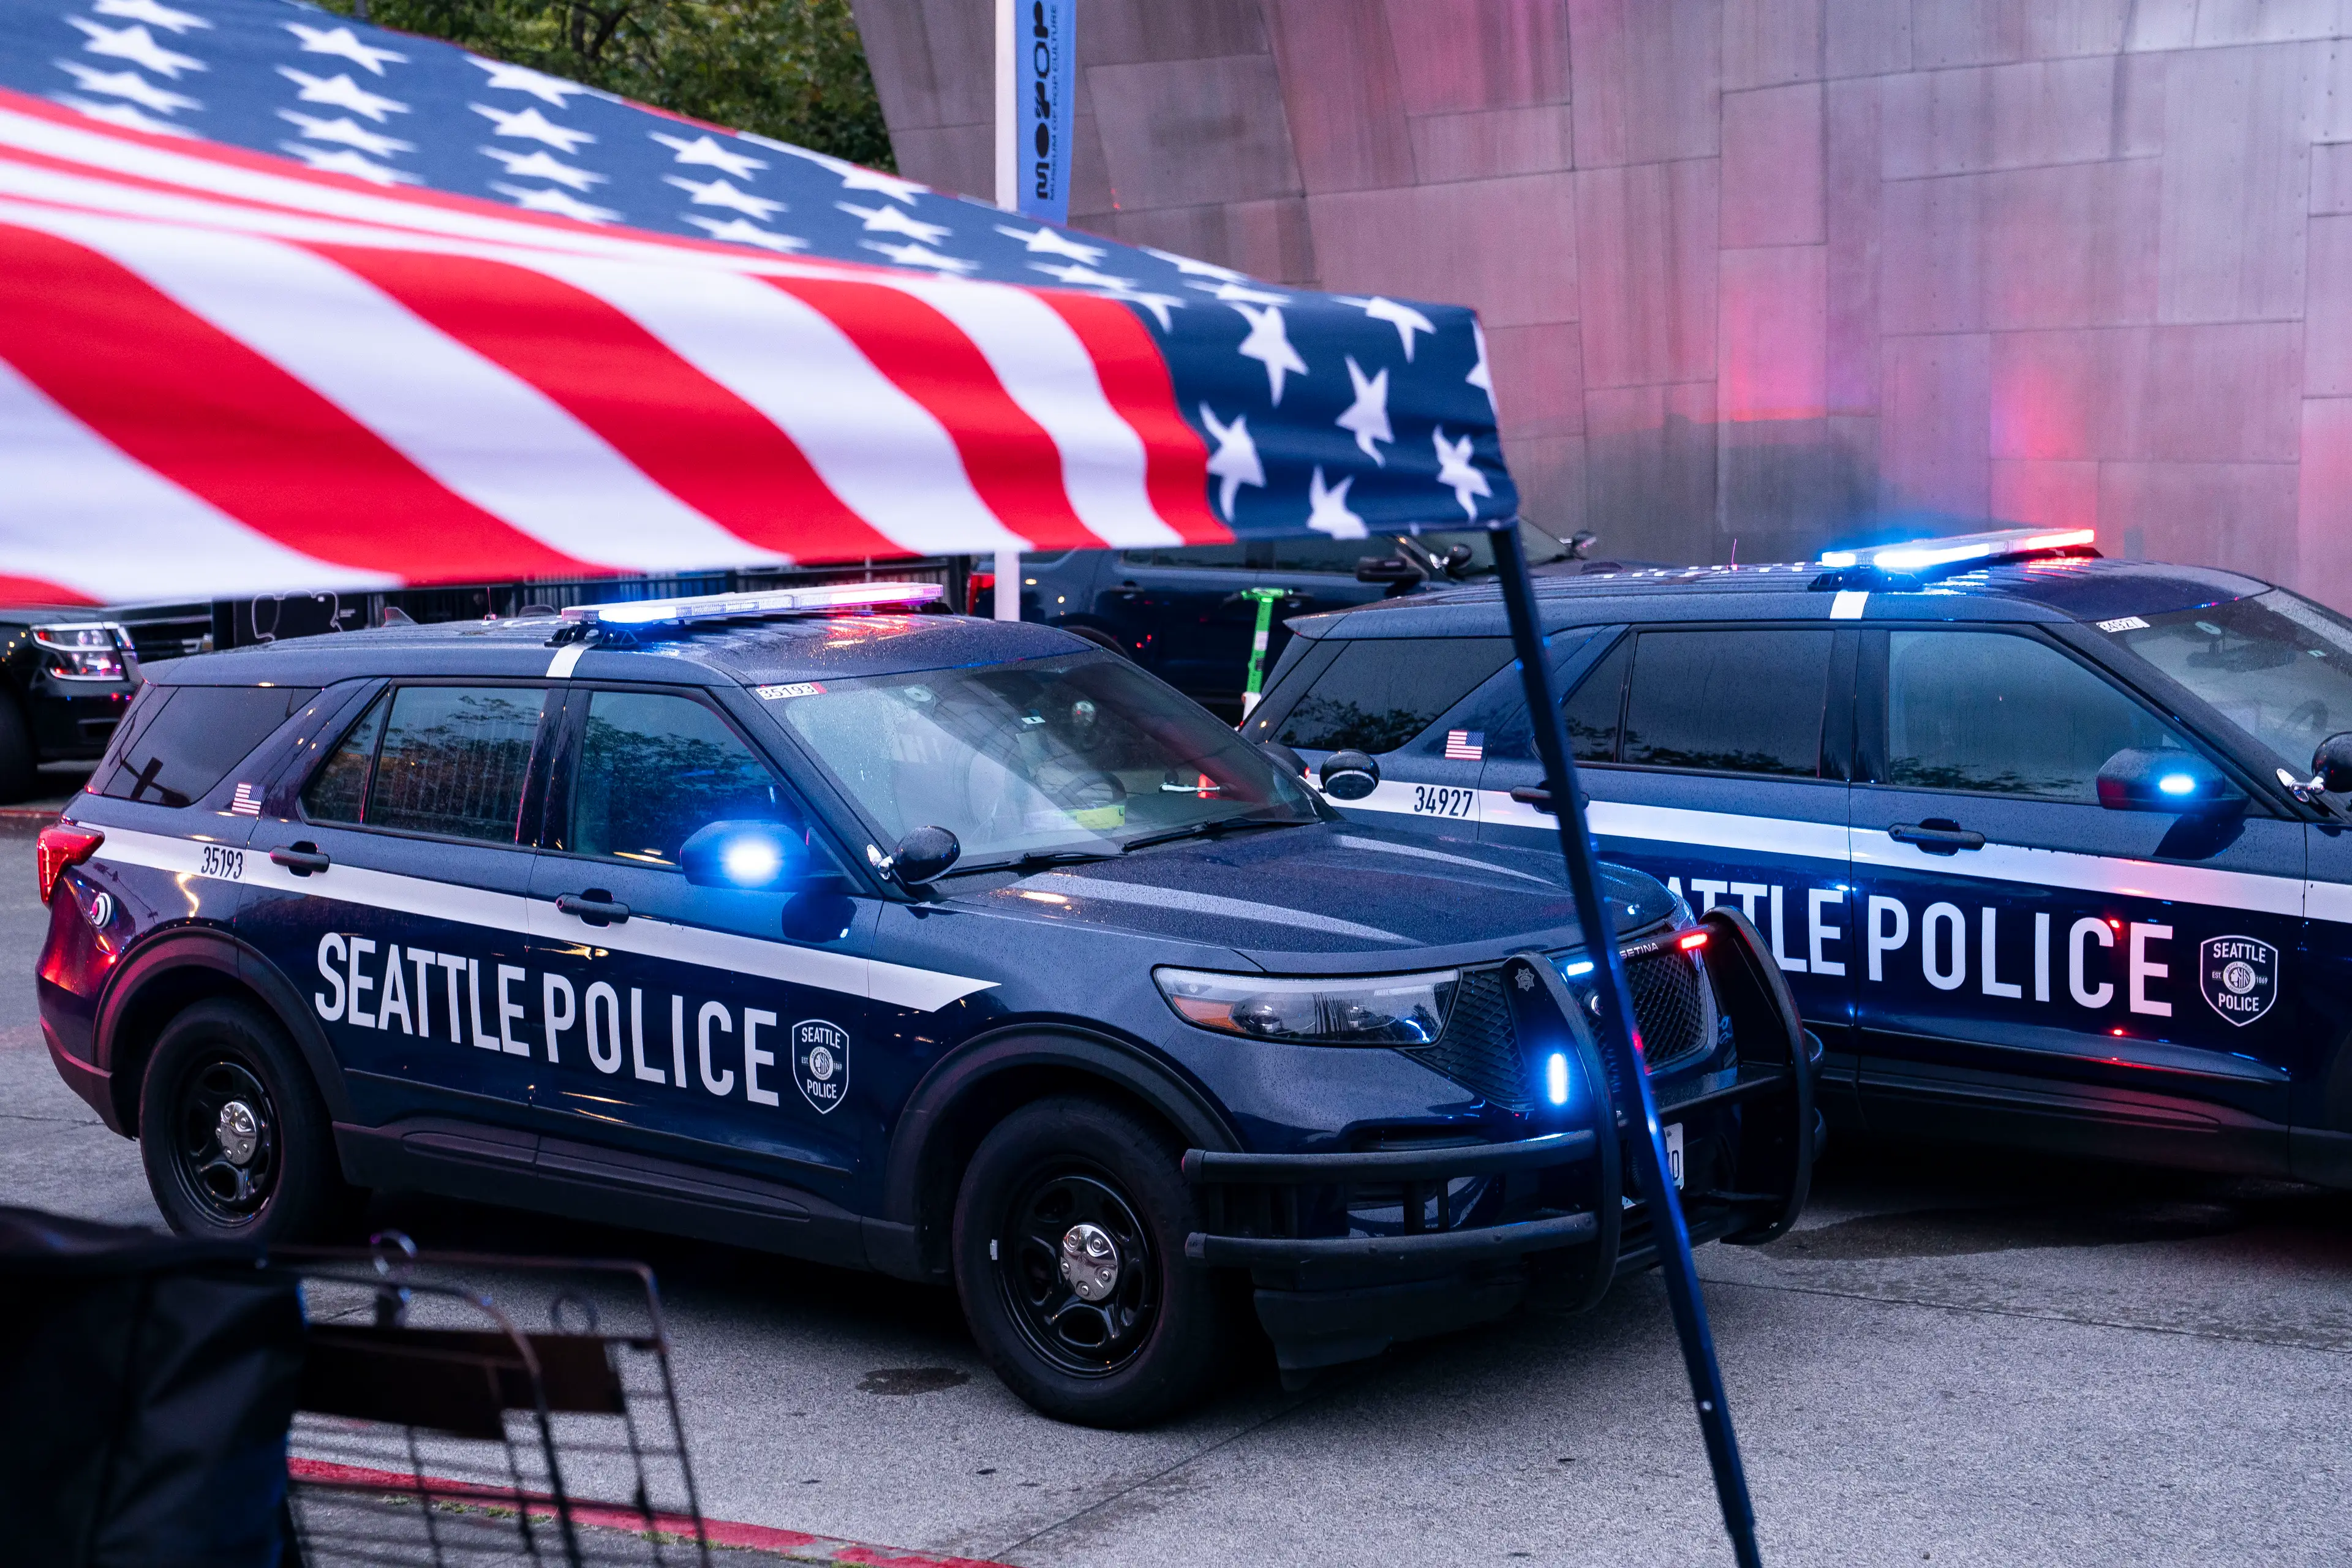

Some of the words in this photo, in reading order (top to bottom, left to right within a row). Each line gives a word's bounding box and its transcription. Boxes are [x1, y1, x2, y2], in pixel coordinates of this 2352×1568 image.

[1050, 4, 1059, 72] CULTURE
[760, 685, 815, 698] 35193
[1414, 786, 1473, 817] 34927
[201, 846, 243, 879] 35193
[1619, 942, 1659, 959] SETINA
[1868, 895, 2173, 1017] POLICE
[2213, 942, 2266, 963] SEATTLE
[2218, 992, 2259, 1012] POLICE
[315, 932, 530, 1057] SEATTLE
[543, 971, 780, 1106] POLICE
[801, 1027, 840, 1049] SEATTLE
[807, 1079, 837, 1099] POLICE
